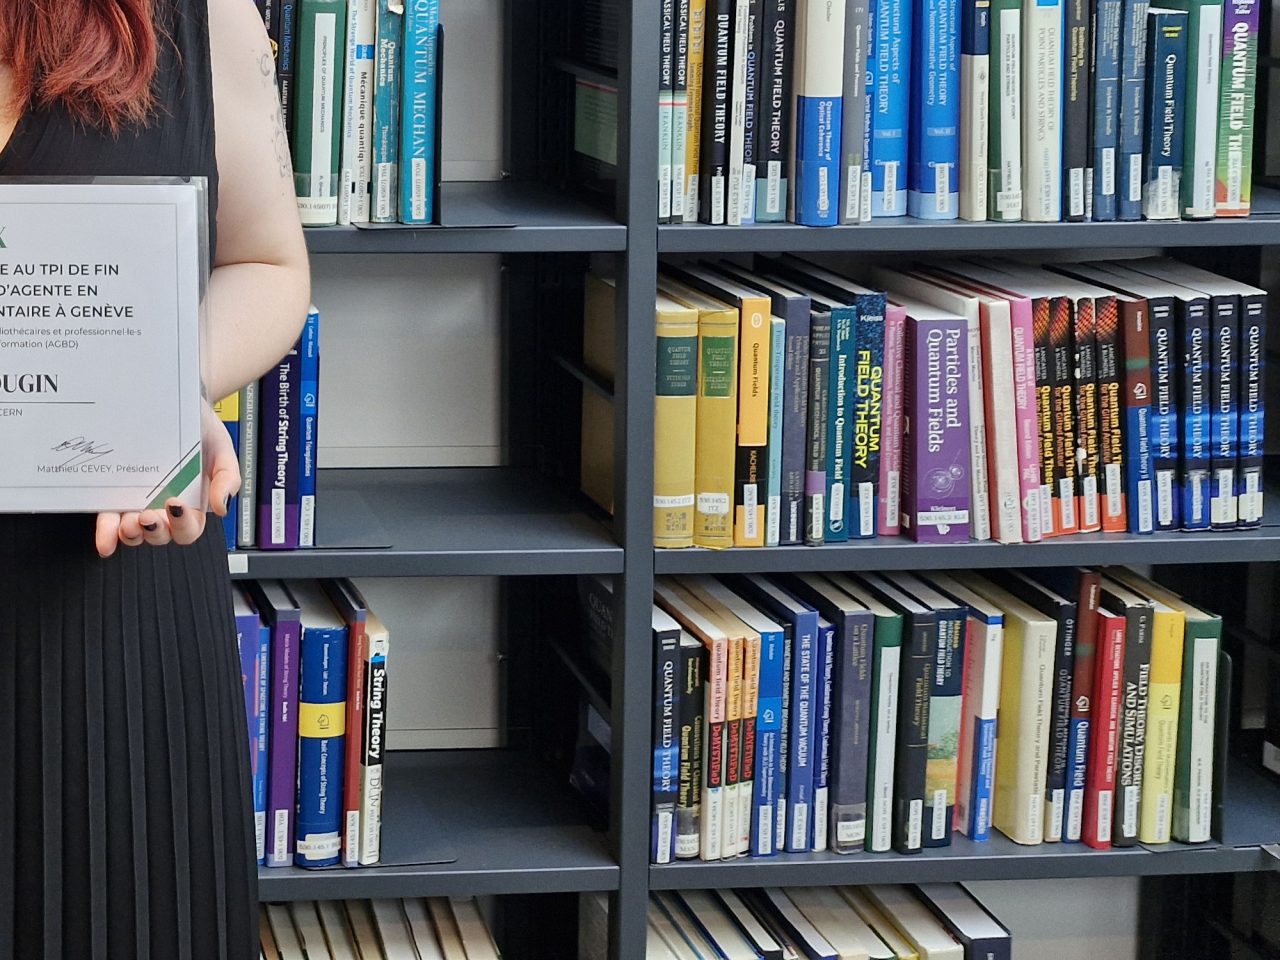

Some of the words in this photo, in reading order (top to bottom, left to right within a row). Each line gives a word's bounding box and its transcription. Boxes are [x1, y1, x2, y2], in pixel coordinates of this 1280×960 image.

[774, 20, 784, 75] QUANTUM
[1164, 54, 1176, 97] Quantum
[773, 79, 782, 108] FIELD
[1164, 99, 1175, 124] Field
[771, 111, 781, 154] THEORY
[1161, 126, 1175, 156] Theory
[13, 264, 34, 275] AU
[39, 264, 63, 275] TPI
[69, 264, 89, 275] DE
[95, 264, 119, 275] FIN
[78, 285, 98, 296] EN
[56, 302, 67, 317] À
[71, 303, 134, 317] GENÈVE
[280, 363, 289, 380] The
[857, 351, 870, 397] FIELD
[926, 330, 943, 406] Quantum
[946, 329, 961, 398] Particles
[279, 382, 289, 407] Birth
[868, 366, 881, 451] QUANTUM
[279, 409, 289, 419] of
[947, 404, 961, 428] and
[276, 421, 288, 451] String
[855, 403, 867, 468] THEORY
[928, 411, 943, 452] Fields
[37, 463, 78, 473] Matthieu
[81, 464, 114, 474] CEVEY,
[117, 463, 160, 473] Président
[275, 453, 288, 487] Theory
[370, 669, 384, 708] String
[370, 711, 383, 758] Theory
